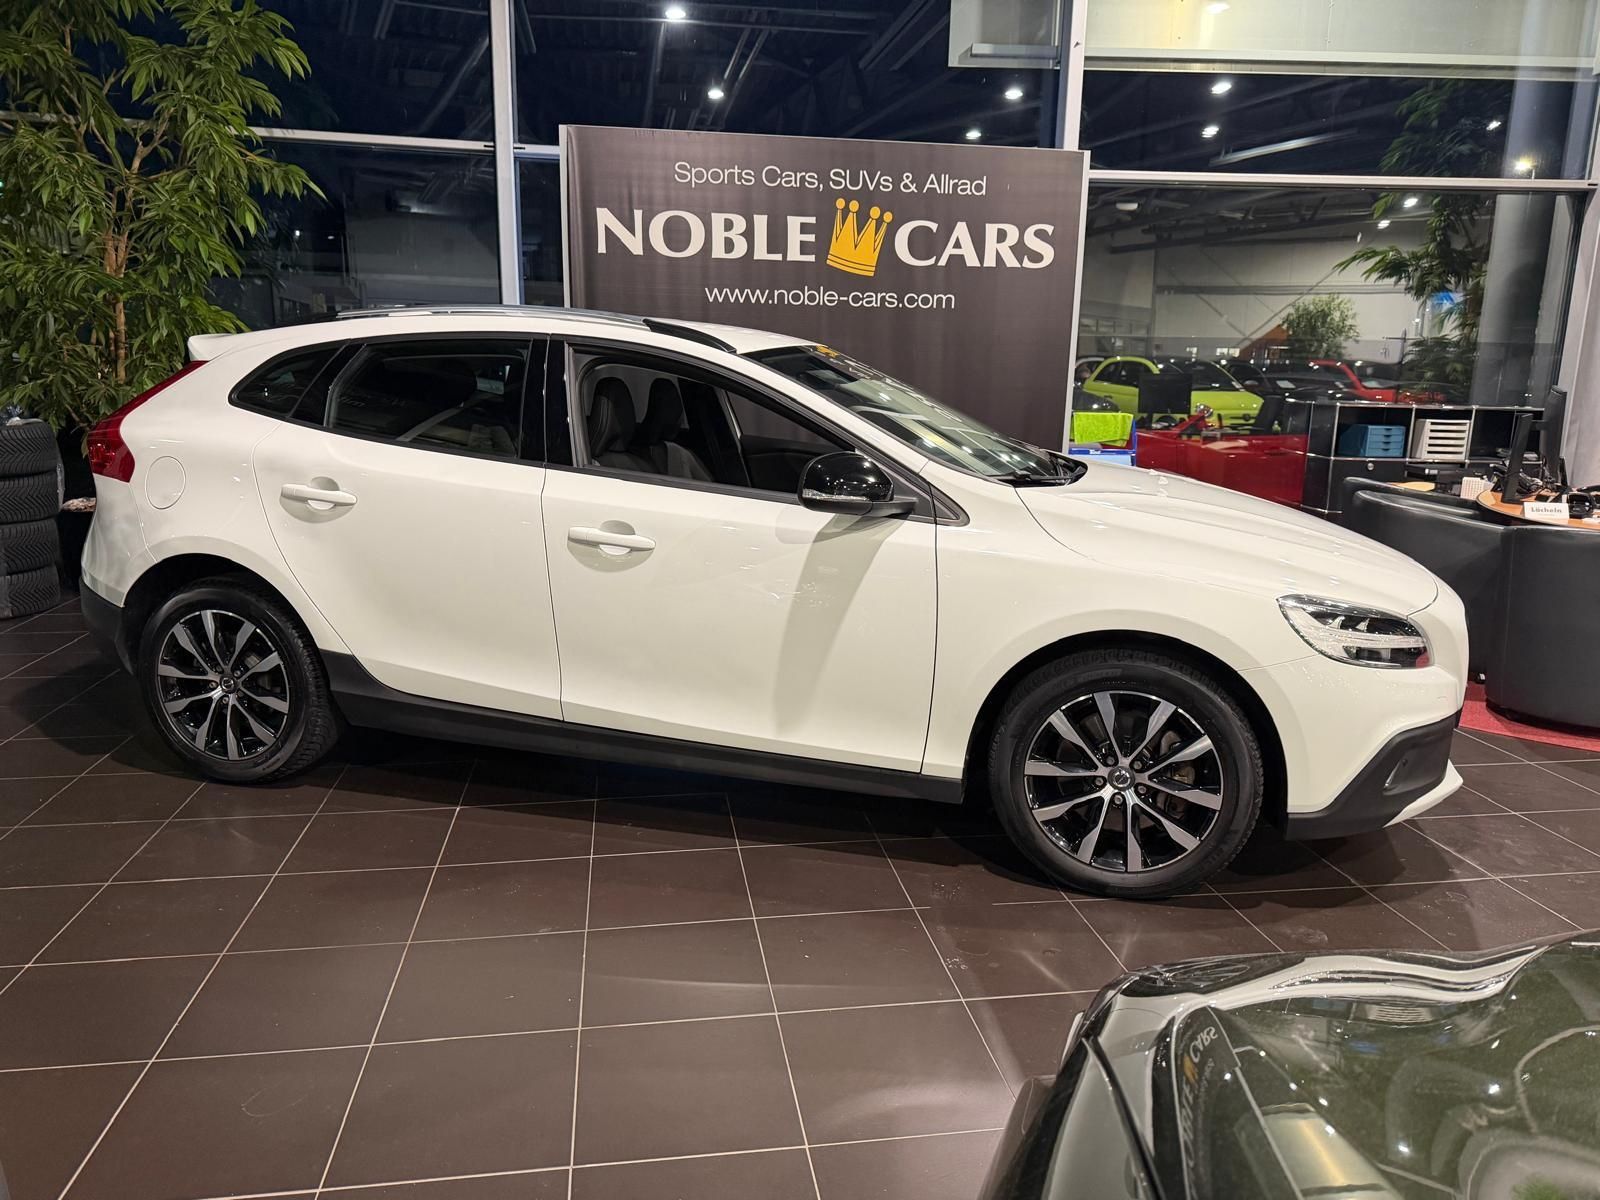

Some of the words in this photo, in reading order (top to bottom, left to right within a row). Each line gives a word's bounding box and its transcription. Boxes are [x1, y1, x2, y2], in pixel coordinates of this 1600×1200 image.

[674, 161, 755, 188] Sports
[761, 165, 824, 191] Cars,
[829, 168, 893, 192] SUVs
[899, 172, 918, 193] &
[922, 173, 987, 196] Allrad
[596, 207, 817, 261] NOBLE
[894, 219, 1055, 269] CARS
[704, 285, 955, 309] www.noble-cars.com
